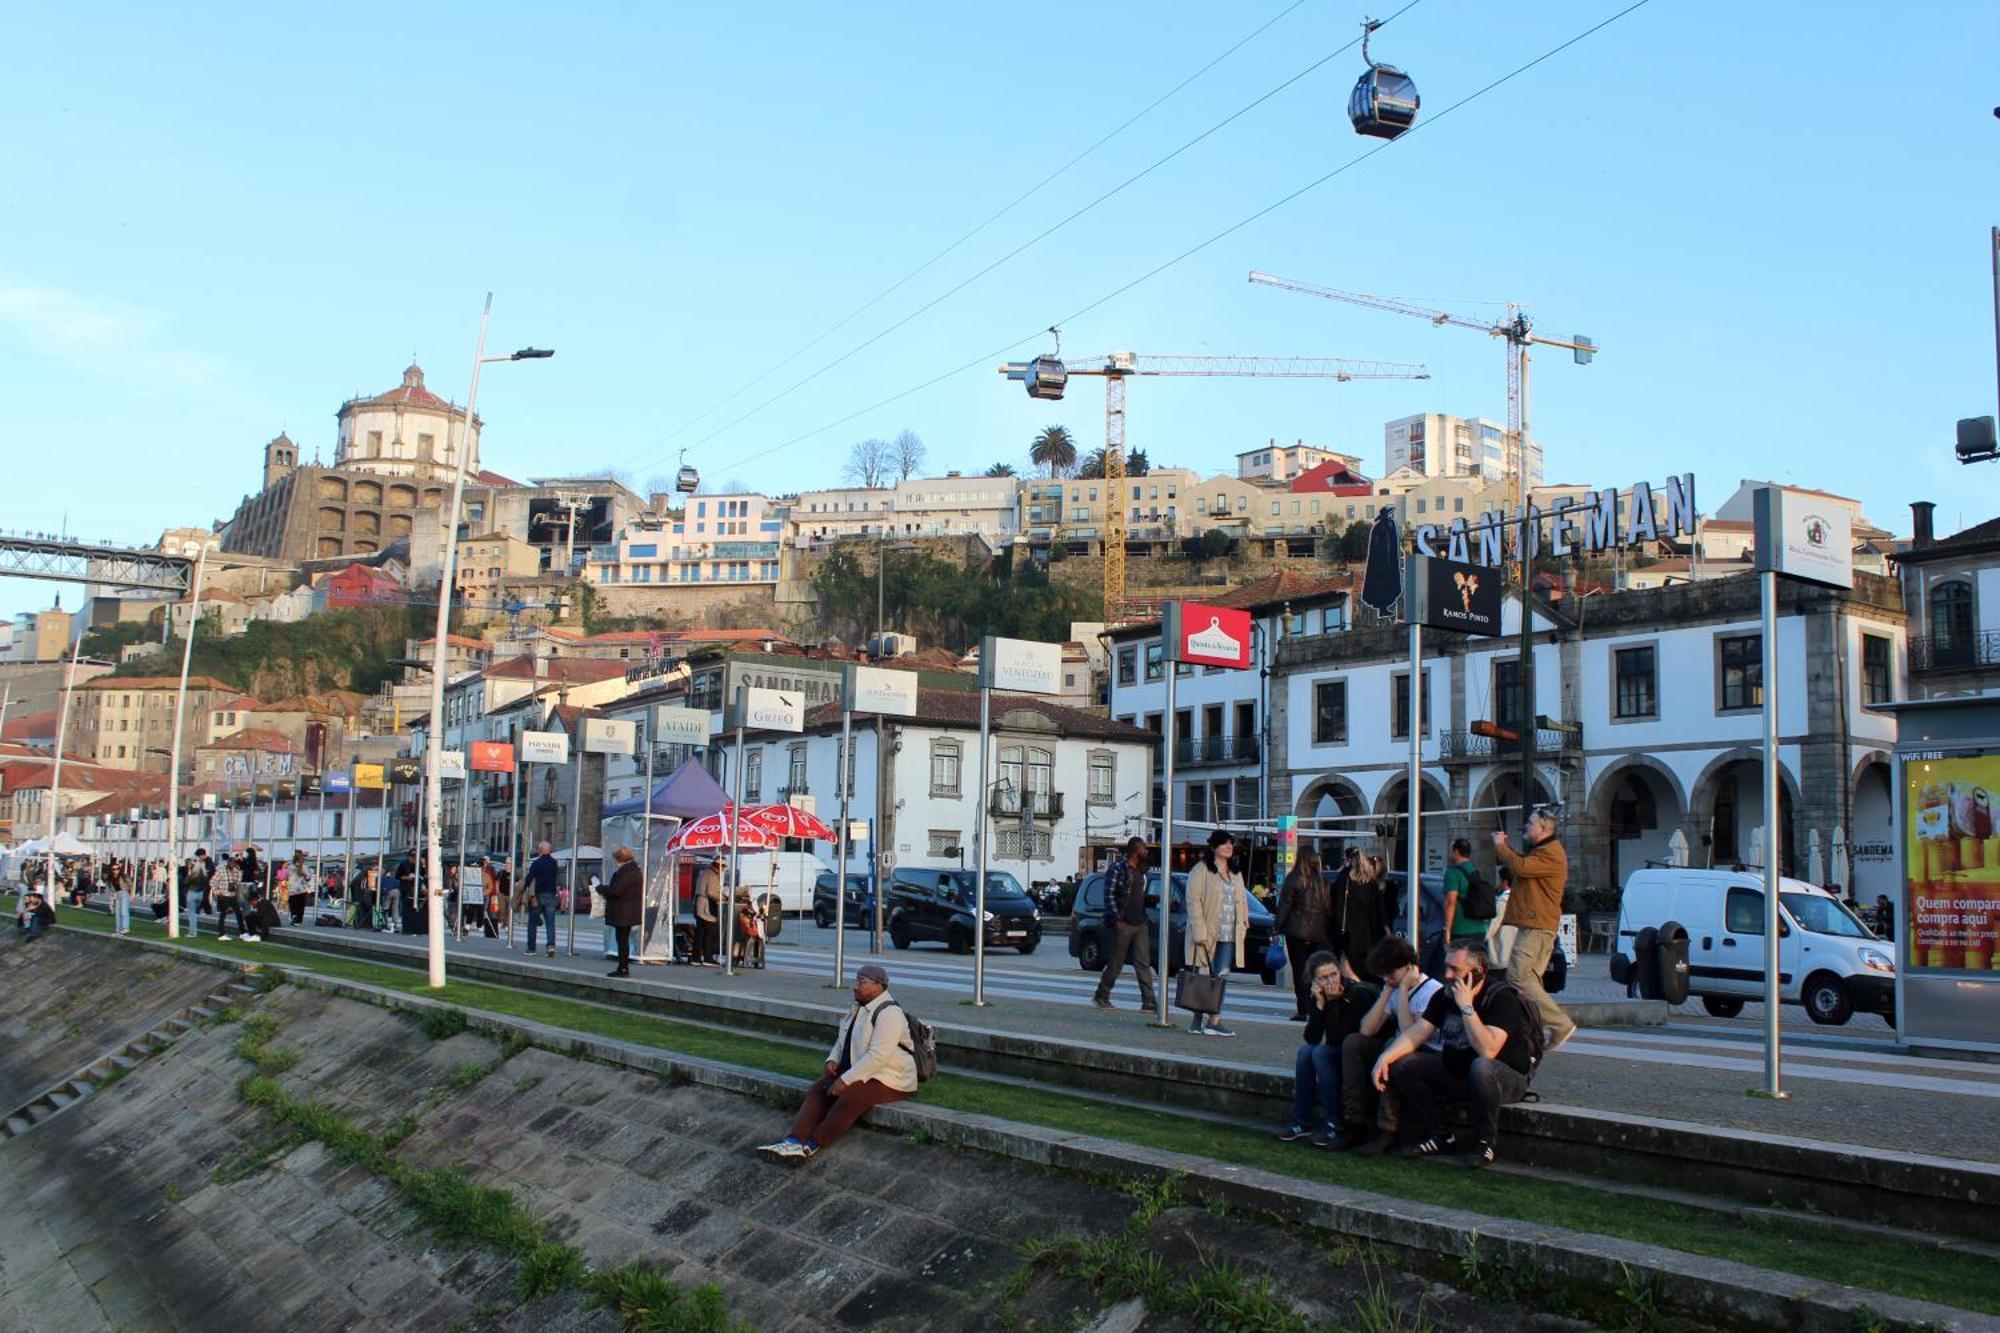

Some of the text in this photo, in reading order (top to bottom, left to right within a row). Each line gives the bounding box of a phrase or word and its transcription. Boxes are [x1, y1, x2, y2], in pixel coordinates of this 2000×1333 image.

[1416, 473, 1695, 567] SANDEMAN
[1922, 751, 1943, 760] FREE
[1854, 844, 1894, 855] SANDEMA
[1917, 896, 1951, 911] Quem
[1917, 911, 1988, 927] compra aqui
